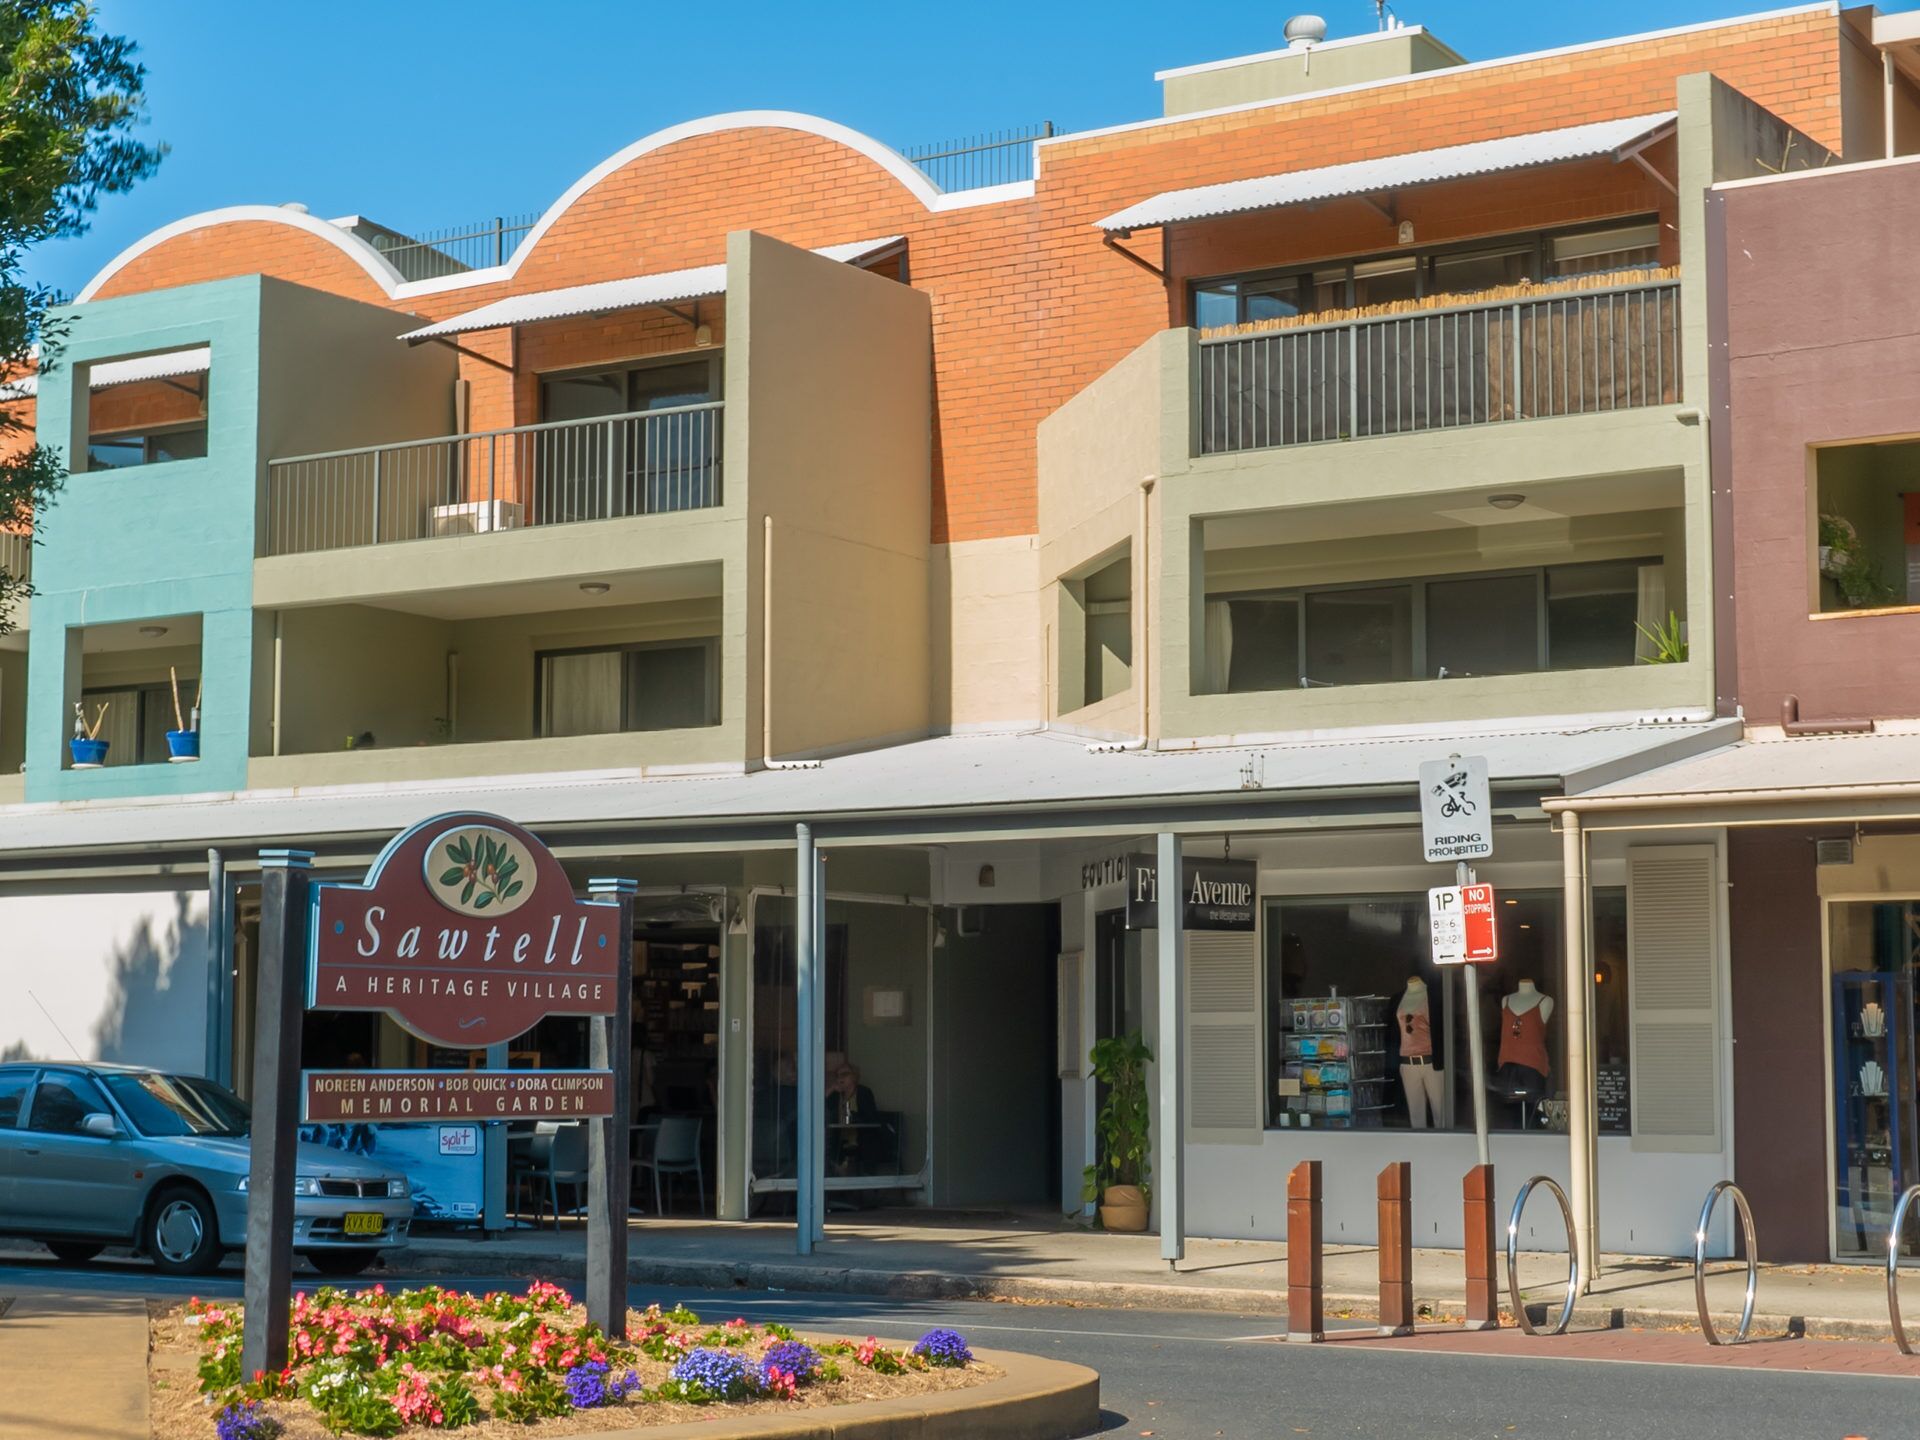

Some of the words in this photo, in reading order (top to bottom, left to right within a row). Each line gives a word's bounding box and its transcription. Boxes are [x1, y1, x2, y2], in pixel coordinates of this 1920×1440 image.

[1434, 833, 1482, 846] RIDING
[1428, 843, 1489, 857] PROHIBITED
[1135, 867, 1159, 902] Fi
[1188, 870, 1251, 906] Avenue
[1435, 892, 1454, 911] 1P
[1468, 888, 1485, 902] NO
[1464, 902, 1491, 915] STOPPING
[357, 905, 588, 965] Sawtell
[335, 975, 347, 992] A
[368, 976, 489, 997] HERITAGE
[507, 981, 602, 1000] VILLAGE
[315, 1079, 366, 1092] NOREEN
[370, 1079, 435, 1092] ANDERSON
[446, 1079, 469, 1092] BOB
[473, 1079, 507, 1092] QUICK
[517, 1079, 548, 1091] DORA
[551, 1078, 604, 1090] CLIMPSON
[341, 1097, 474, 1114] MEMORIAL
[496, 1096, 585, 1112] GARDEN
[441, 1129, 471, 1151] split
[345, 1215, 365, 1229] XVX
